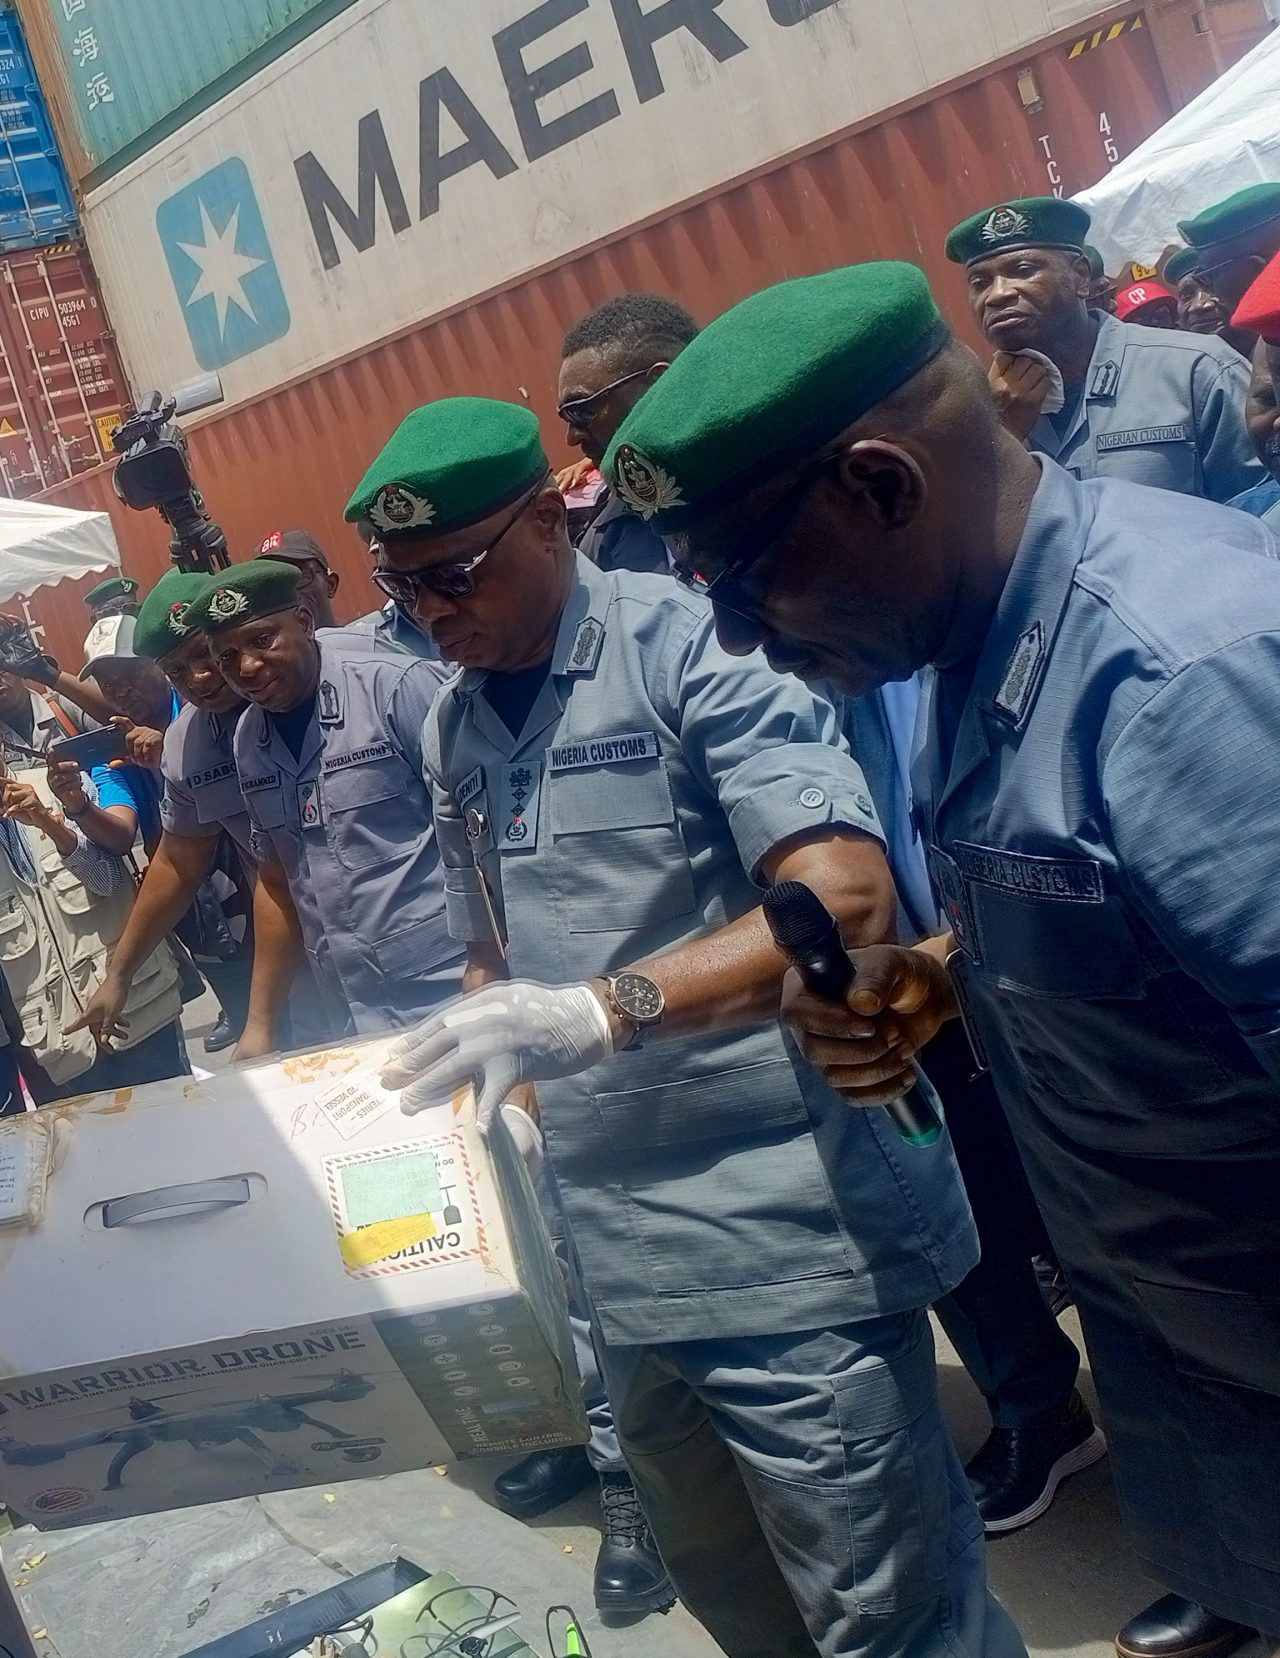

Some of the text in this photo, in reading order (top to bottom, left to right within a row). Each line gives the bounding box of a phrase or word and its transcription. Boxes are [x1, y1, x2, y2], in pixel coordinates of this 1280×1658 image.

[293, 0, 850, 270] MAER
[30, 307, 49, 321] CIPU
[58, 298, 86, 316] 503964
[62, 314, 81, 328] 45G1
[1097, 425, 1182, 450] NIGERIAN CUSTOMS
[325, 744, 388, 770] NIGERIA CUSTOMS
[552, 737, 647, 767] NIGERIA CUSTOMS
[5, 1331, 366, 1406] WARRIOR DRONE
[521, 1436, 572, 1449] INCLUDED
